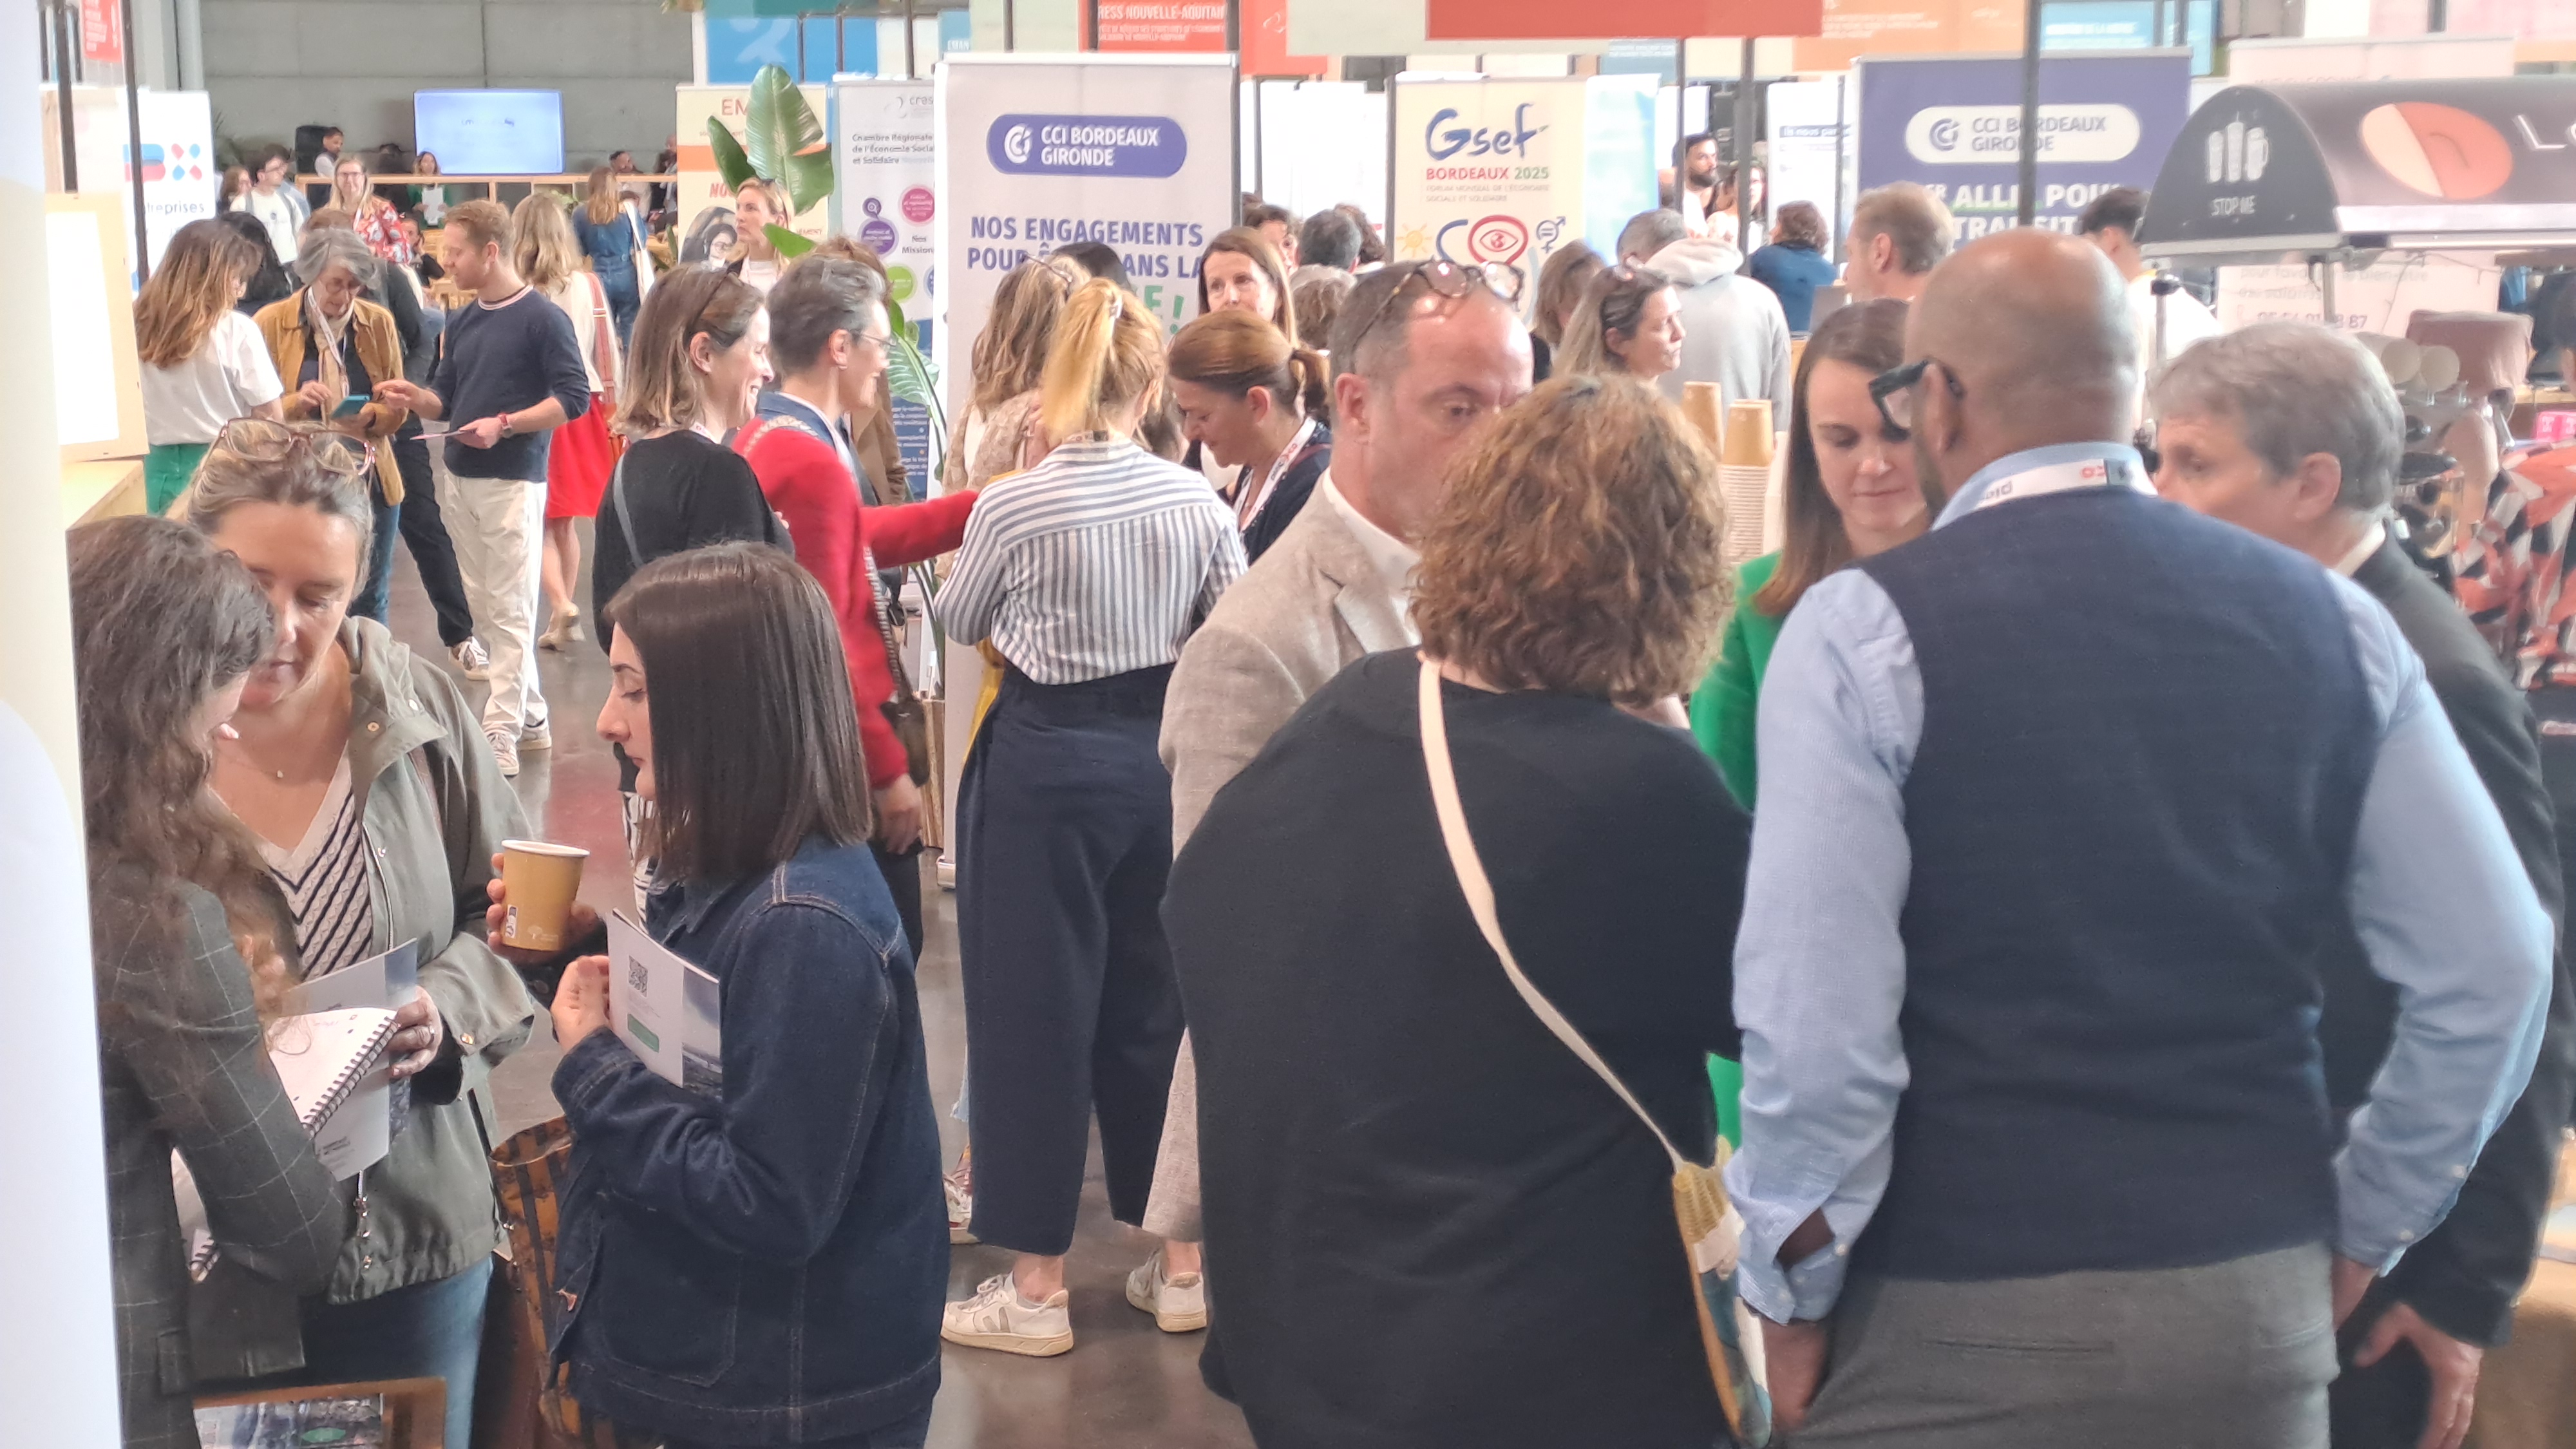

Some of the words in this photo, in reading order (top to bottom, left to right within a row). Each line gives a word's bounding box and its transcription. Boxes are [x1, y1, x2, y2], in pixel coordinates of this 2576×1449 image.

[1099, 5, 1124, 20] RESS
[721, 99, 748, 116] EM
[909, 96, 933, 106] cres
[1425, 102, 1549, 160] Gsef
[1972, 117, 2000, 133] CCI
[2006, 116, 2107, 132] BRDEAUX
[1041, 126, 1067, 146] CCI
[1070, 126, 1160, 147] BORDEAUX
[1971, 135, 2054, 151] GIRODE
[1041, 146, 1115, 166] GIRONDE
[1426, 166, 1510, 180] BORDEAUX
[1513, 166, 1549, 180] 2025
[1953, 184, 2020, 208] ALLI
[2046, 184, 2121, 208] POU
[144, 200, 205, 215] treprises
[971, 216, 1017, 240] NOS
[1025, 218, 1204, 247] ENGAGEMENTS
[1123, 254, 1170, 278] ANS
